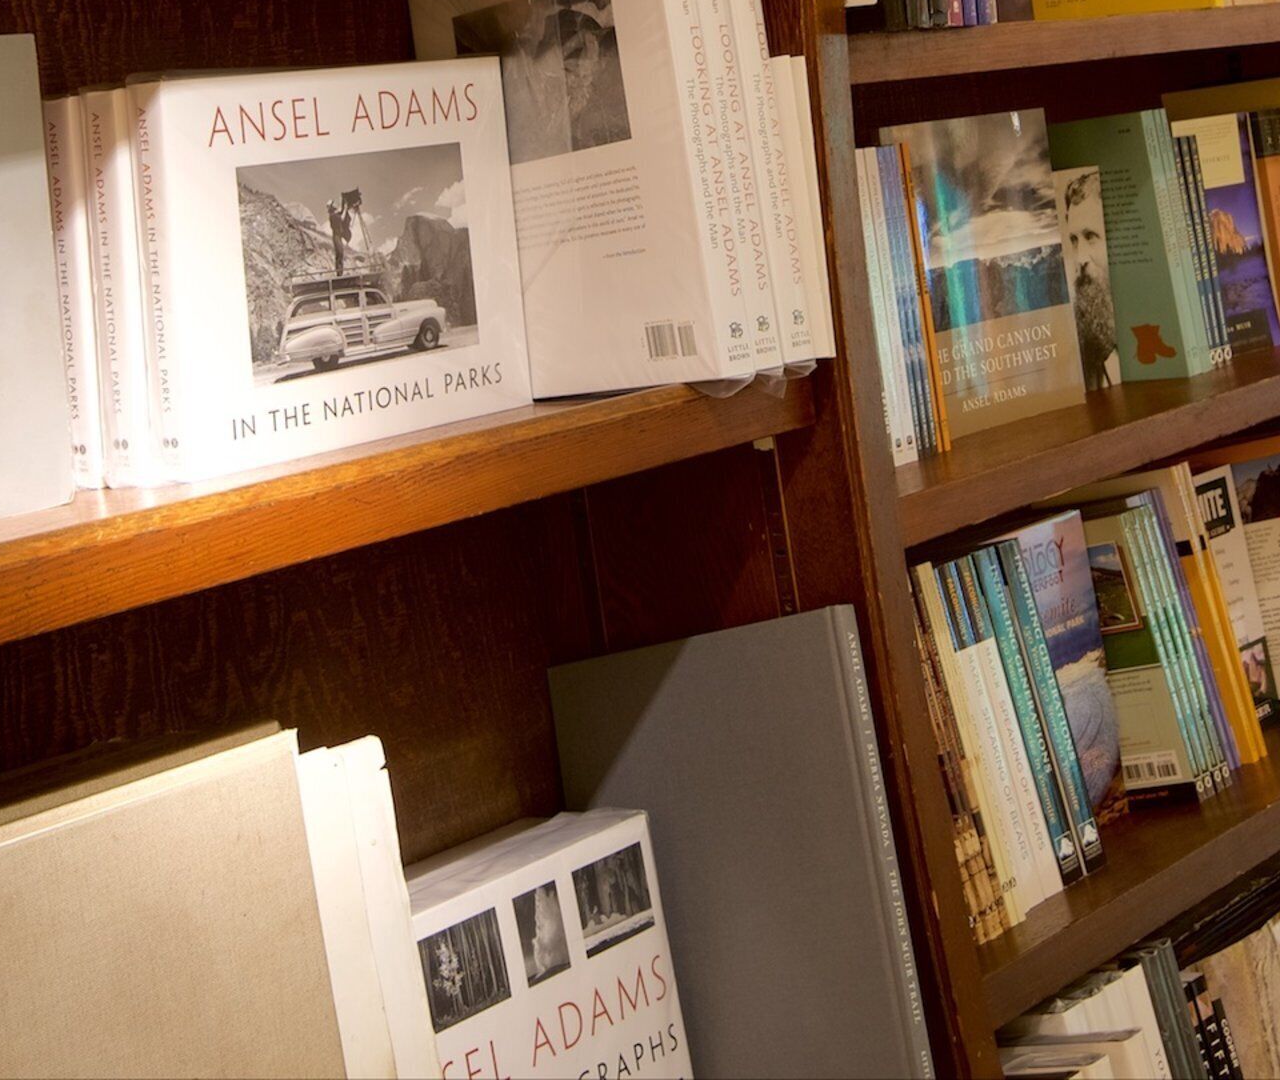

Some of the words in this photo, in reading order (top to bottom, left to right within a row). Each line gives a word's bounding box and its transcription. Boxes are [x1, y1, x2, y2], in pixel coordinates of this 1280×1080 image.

[686, 79, 694, 99] The
[690, 24, 713, 116] LOOKING
[716, 77, 724, 97] The
[720, 24, 741, 113] LOOKING
[92, 112, 103, 159] ANSEL
[137, 107, 149, 152] ANSEL
[208, 96, 330, 148] ANSEL
[351, 83, 479, 133] ADAMS
[705, 124, 719, 146] AT
[734, 120, 746, 143] AT
[48, 121, 60, 166] ANSEL
[689, 102, 708, 175] Photographs
[95, 167, 108, 224] ADAMS
[142, 163, 155, 220] ADAMS
[701, 178, 713, 198] and
[711, 156, 727, 215] ANSEL
[730, 172, 740, 192] and
[739, 152, 756, 211] ANSEL
[52, 176, 64, 232] ADAMS
[704, 201, 714, 220] the
[733, 194, 743, 214] the
[775, 148, 792, 206] ANSEL
[785, 215, 802, 285] ADAMS
[57, 239, 65, 254] IN
[101, 231, 108, 246] IN
[148, 228, 156, 243] IN
[706, 223, 719, 249] Man
[736, 218, 746, 243] Man
[60, 261, 69, 287] THE
[103, 255, 112, 280] THE
[150, 252, 160, 276] THE
[722, 224, 742, 297] ADAMS
[749, 219, 767, 291] ADAMS
[63, 295, 75, 368] NATIONAL
[104, 287, 117, 361] NATIONAL
[153, 284, 166, 359] NATIONAL
[951, 336, 994, 361] GRAND
[996, 324, 1053, 353] CANYON
[955, 365, 978, 382] THE
[979, 344, 1058, 376] SOUTHWEST
[69, 377, 80, 420] PARKS
[112, 371, 122, 414] PARKS
[161, 369, 172, 413] PARKS
[232, 412, 256, 441] IN
[268, 403, 312, 432] THE
[323, 379, 434, 419] NATIONAL
[443, 362, 503, 393] PARKS
[961, 395, 991, 413] ANSEL
[993, 385, 1028, 405] ADAMS
[847, 631, 860, 672] ANSEL
[855, 676, 869, 721] ADAMS
[1038, 644, 1076, 761] GENERATIONS
[867, 743, 880, 791] SIERRA
[875, 795, 890, 848] NEVADA
[1009, 809, 1029, 861] BEARS
[1027, 802, 1046, 851] BEARS
[889, 870, 900, 895] THE
[893, 900, 907, 936] JOHN
[901, 940, 914, 977] MUIR
[533, 955, 667, 1067] ADAMS
[908, 981, 921, 1024] TRAIL
